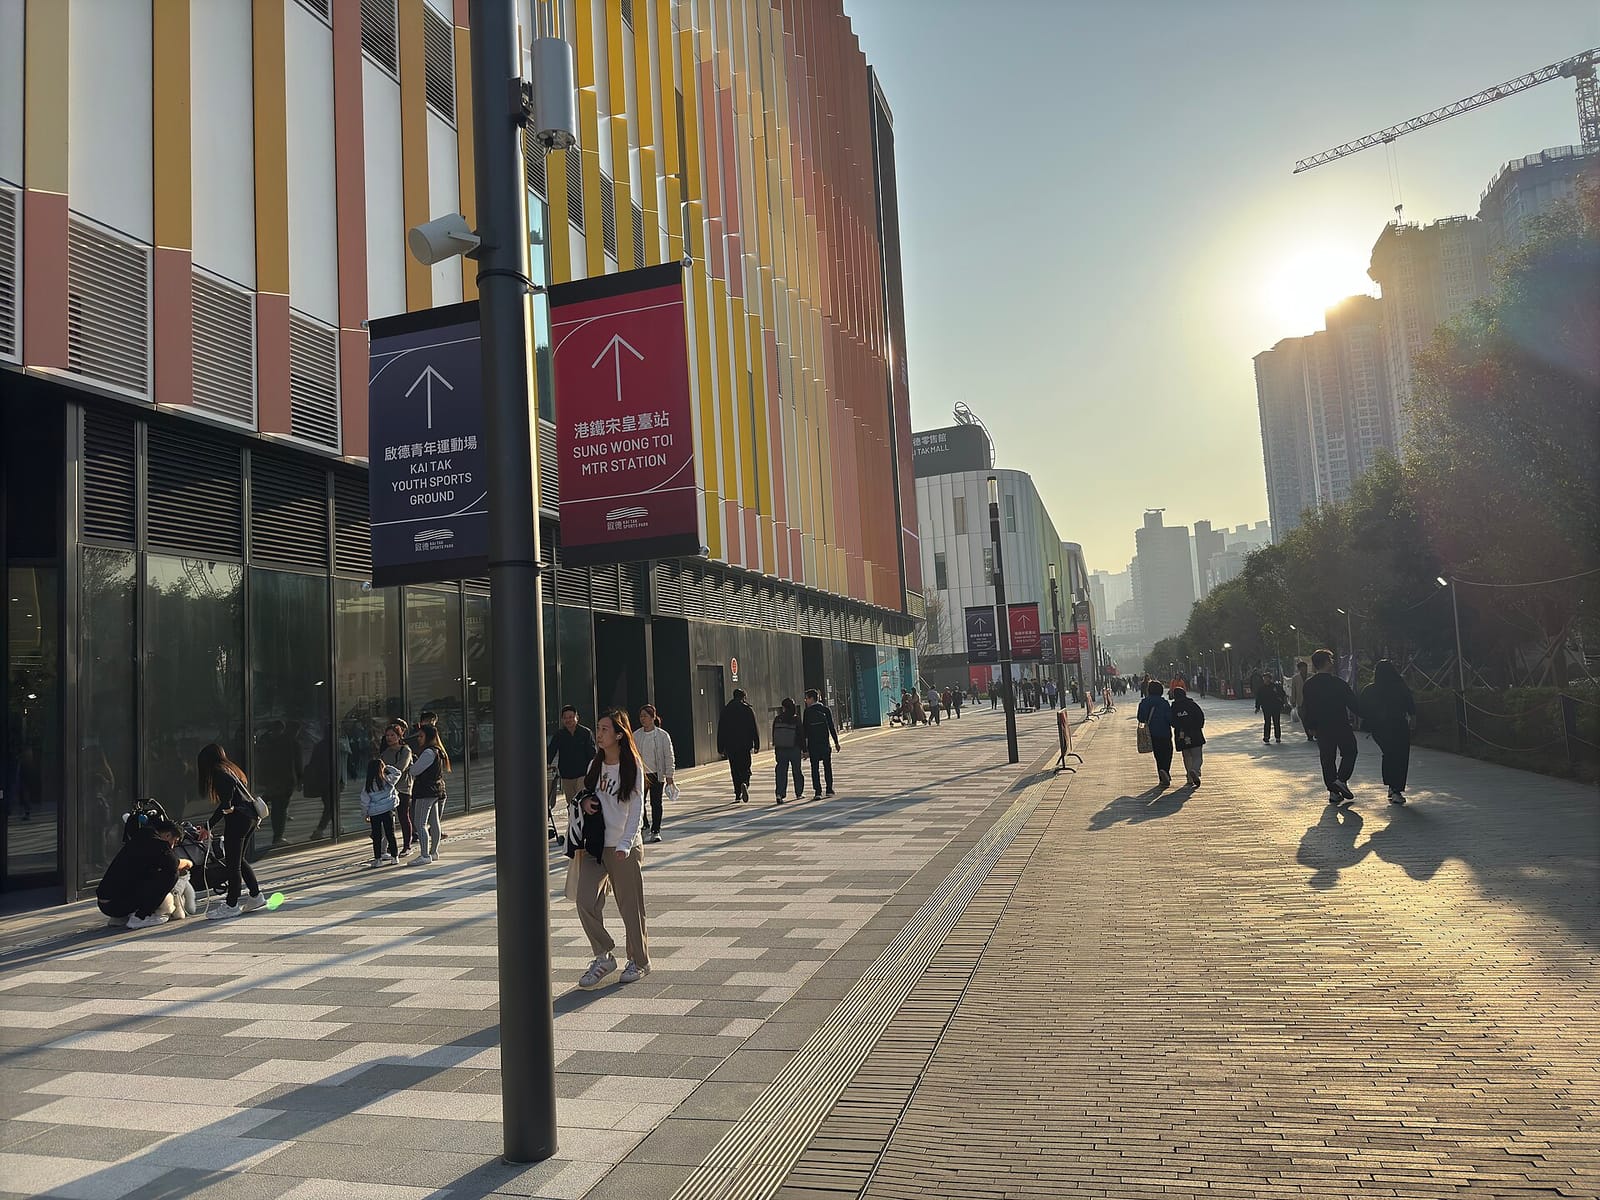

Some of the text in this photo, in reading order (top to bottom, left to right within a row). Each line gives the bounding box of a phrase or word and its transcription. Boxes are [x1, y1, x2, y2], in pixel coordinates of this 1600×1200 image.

[574, 411, 670, 439] 港鐵宋皇臺站
[384, 435, 478, 461] 啟德青年運動場
[573, 434, 673, 459] SUNG WONG TOI
[917, 446, 930, 455] TAK
[930, 444, 950, 453] MALL
[410, 459, 452, 474] KAI TAK
[582, 453, 667, 476] MTR STATION
[391, 472, 472, 492] YOUTH SPORTS
[410, 490, 455, 505] GROUND
